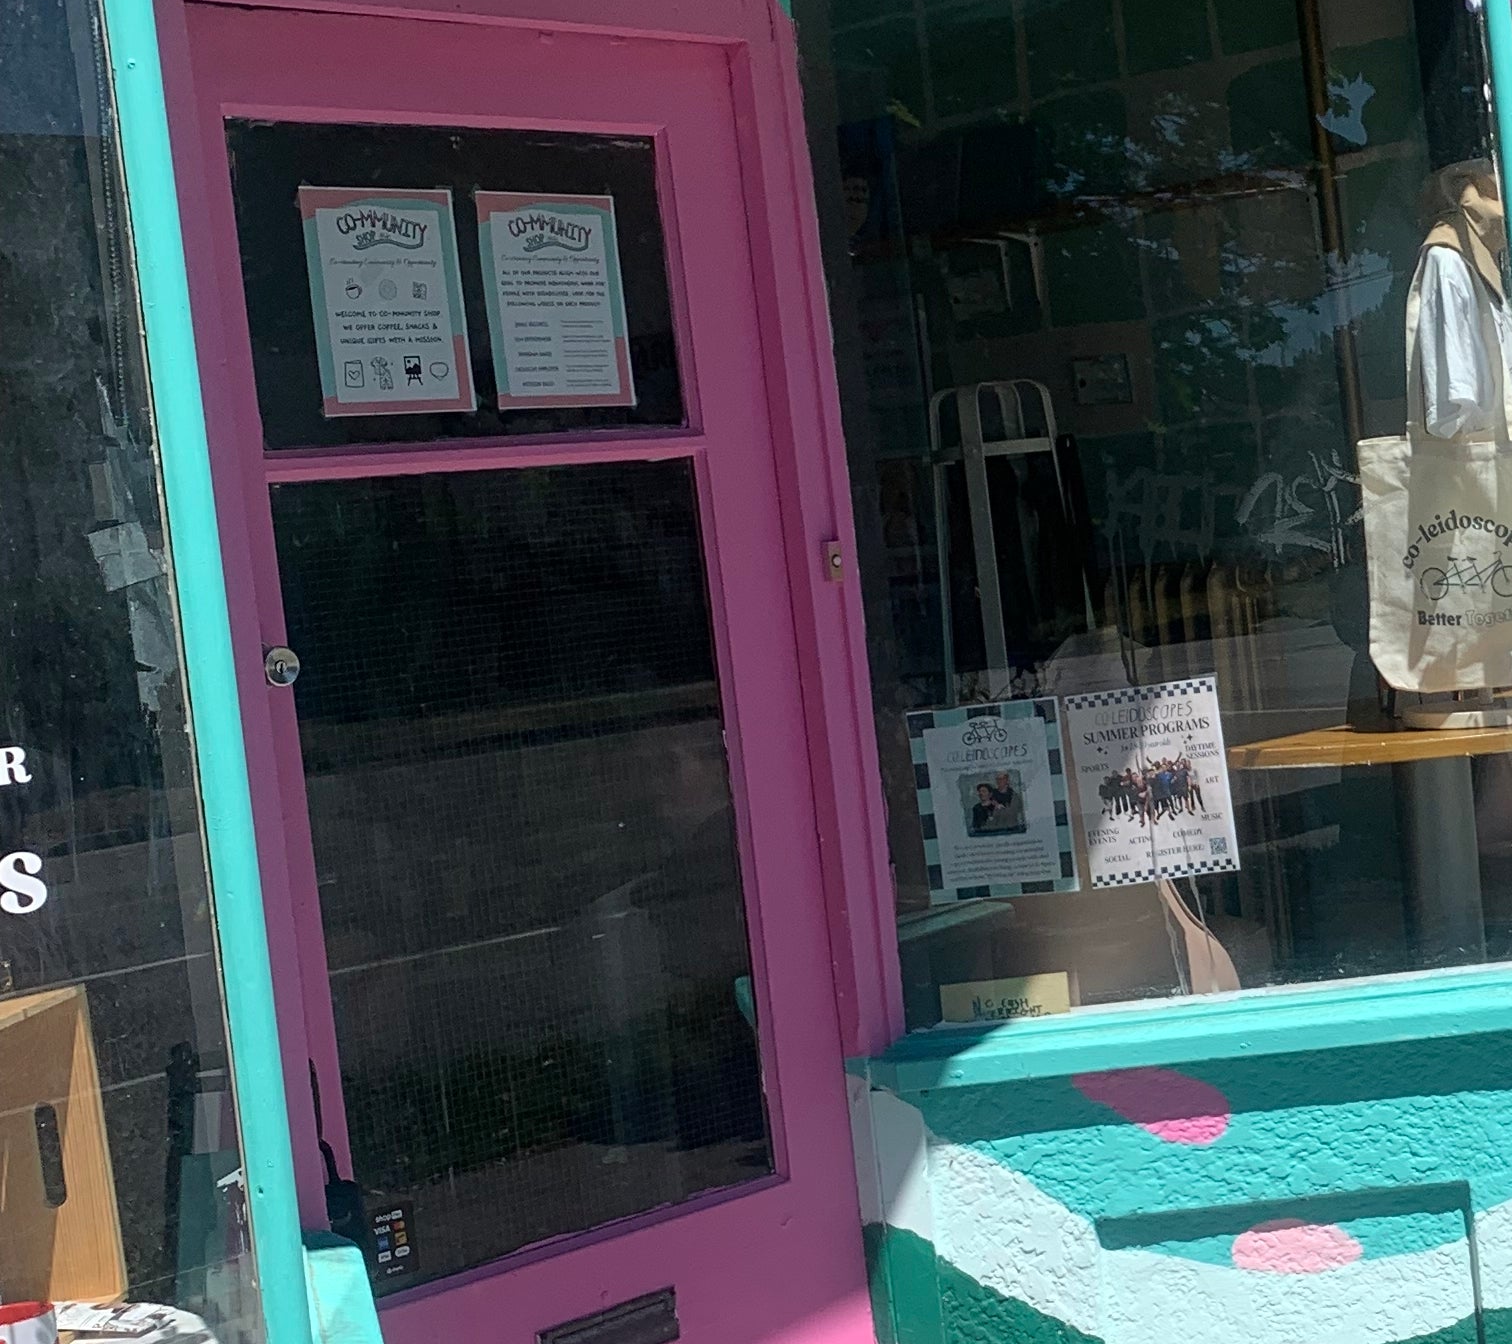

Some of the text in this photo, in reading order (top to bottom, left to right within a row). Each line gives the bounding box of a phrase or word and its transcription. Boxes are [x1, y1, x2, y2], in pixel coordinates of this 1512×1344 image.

[335, 310, 367, 318] WELCOME
[1417, 609, 1462, 627] Better
[1083, 716, 1211, 746] SUMMER PROGRAMS
[1184, 741, 1217, 752] DAYTIME
[1185, 749, 1220, 760] SESSIONS
[1080, 761, 1110, 774] SPORTS
[1204, 775, 1220, 785] ART
[1200, 812, 1224, 822] MUSIC
[1087, 827, 1120, 839] EVENING
[1088, 836, 1118, 847] EVENTS
[1104, 853, 1131, 865] SOCIAL
[373, 1224, 391, 1235] VISA
